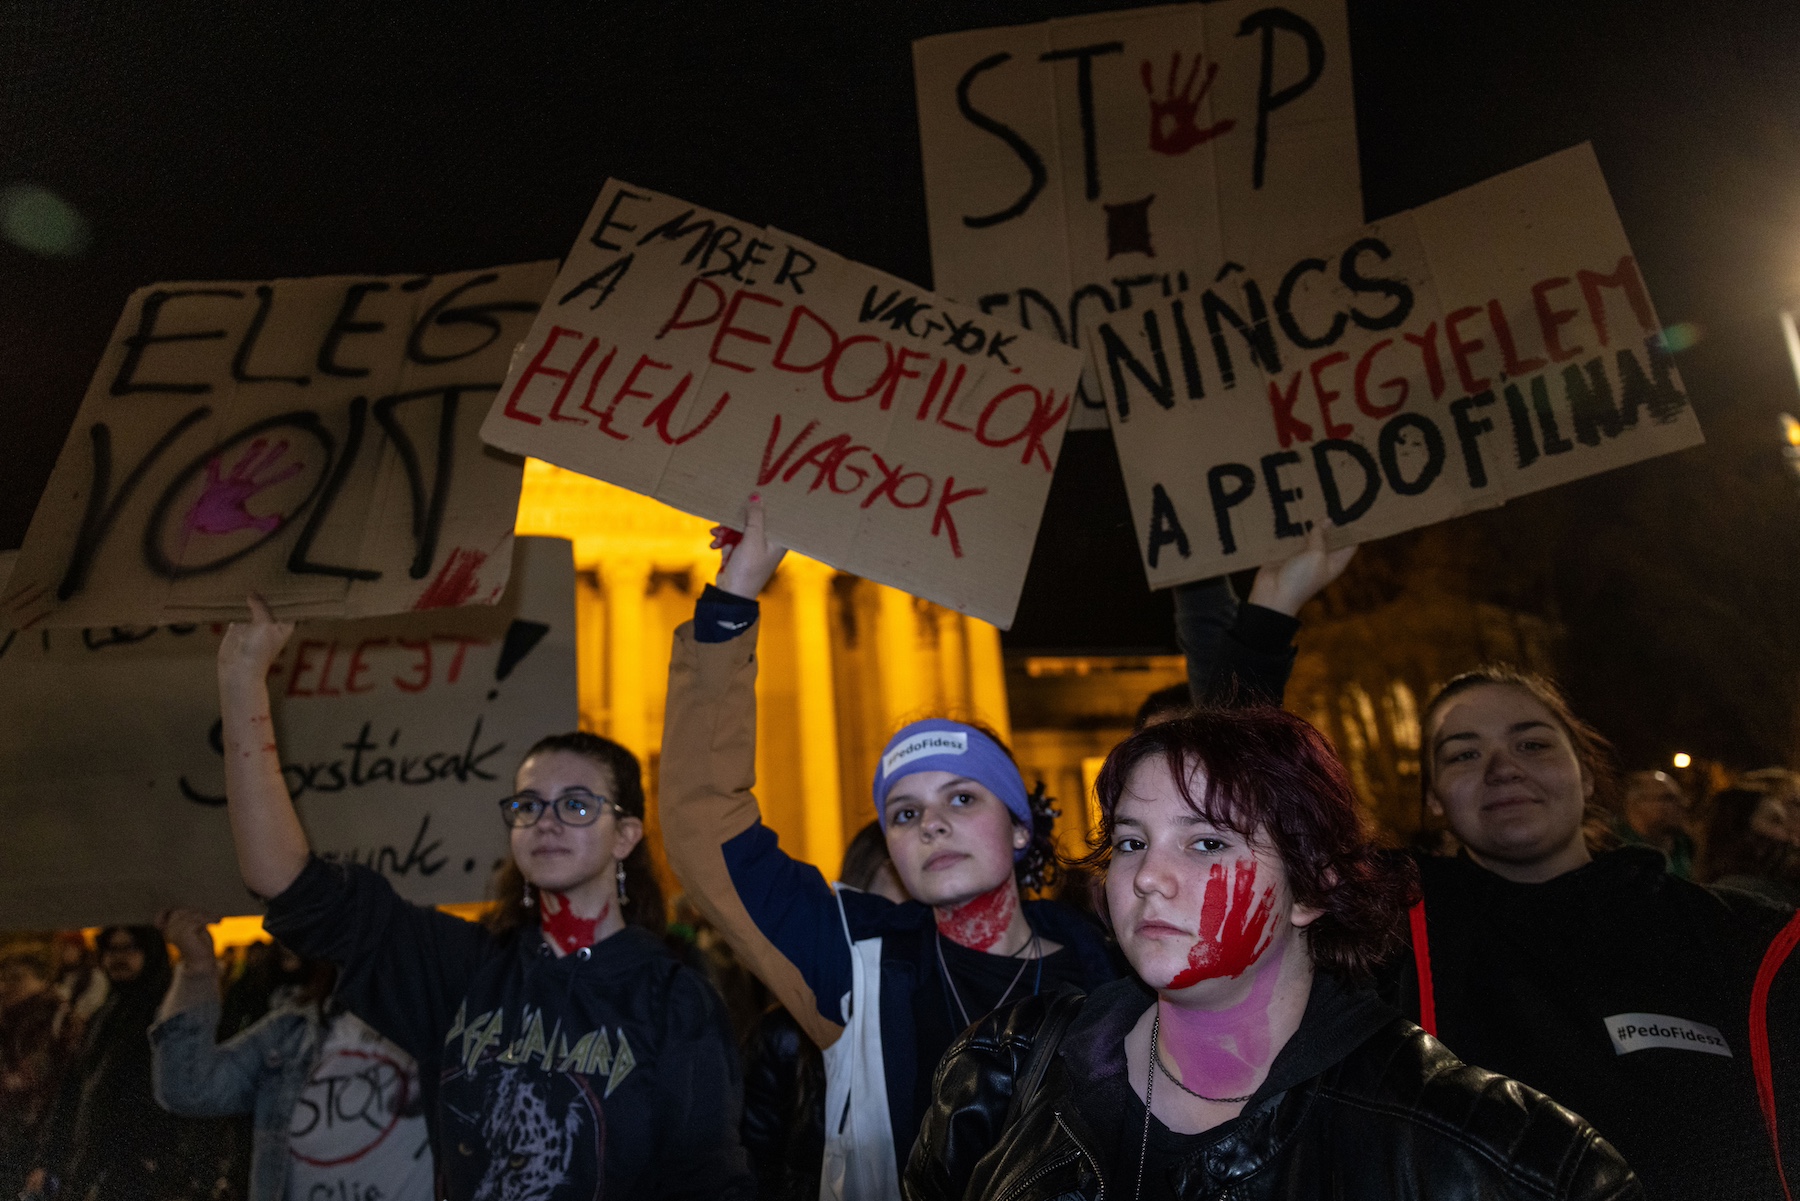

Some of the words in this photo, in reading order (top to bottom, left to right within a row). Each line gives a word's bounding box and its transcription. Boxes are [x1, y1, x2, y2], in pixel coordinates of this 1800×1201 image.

[110, 273, 542, 396] ELÉG
[559, 253, 634, 310] A
[590, 188, 817, 294] EMBER
[859, 285, 1019, 366] VAGYOK
[1269, 255, 1656, 448] KEGYELEM
[57, 383, 503, 602] VOLT
[503, 325, 731, 440] ELLEN
[756, 414, 987, 559] VAGYOK
[1149, 483, 1191, 570] A
[1616, 1024, 1725, 1047] #PedoFidesz
